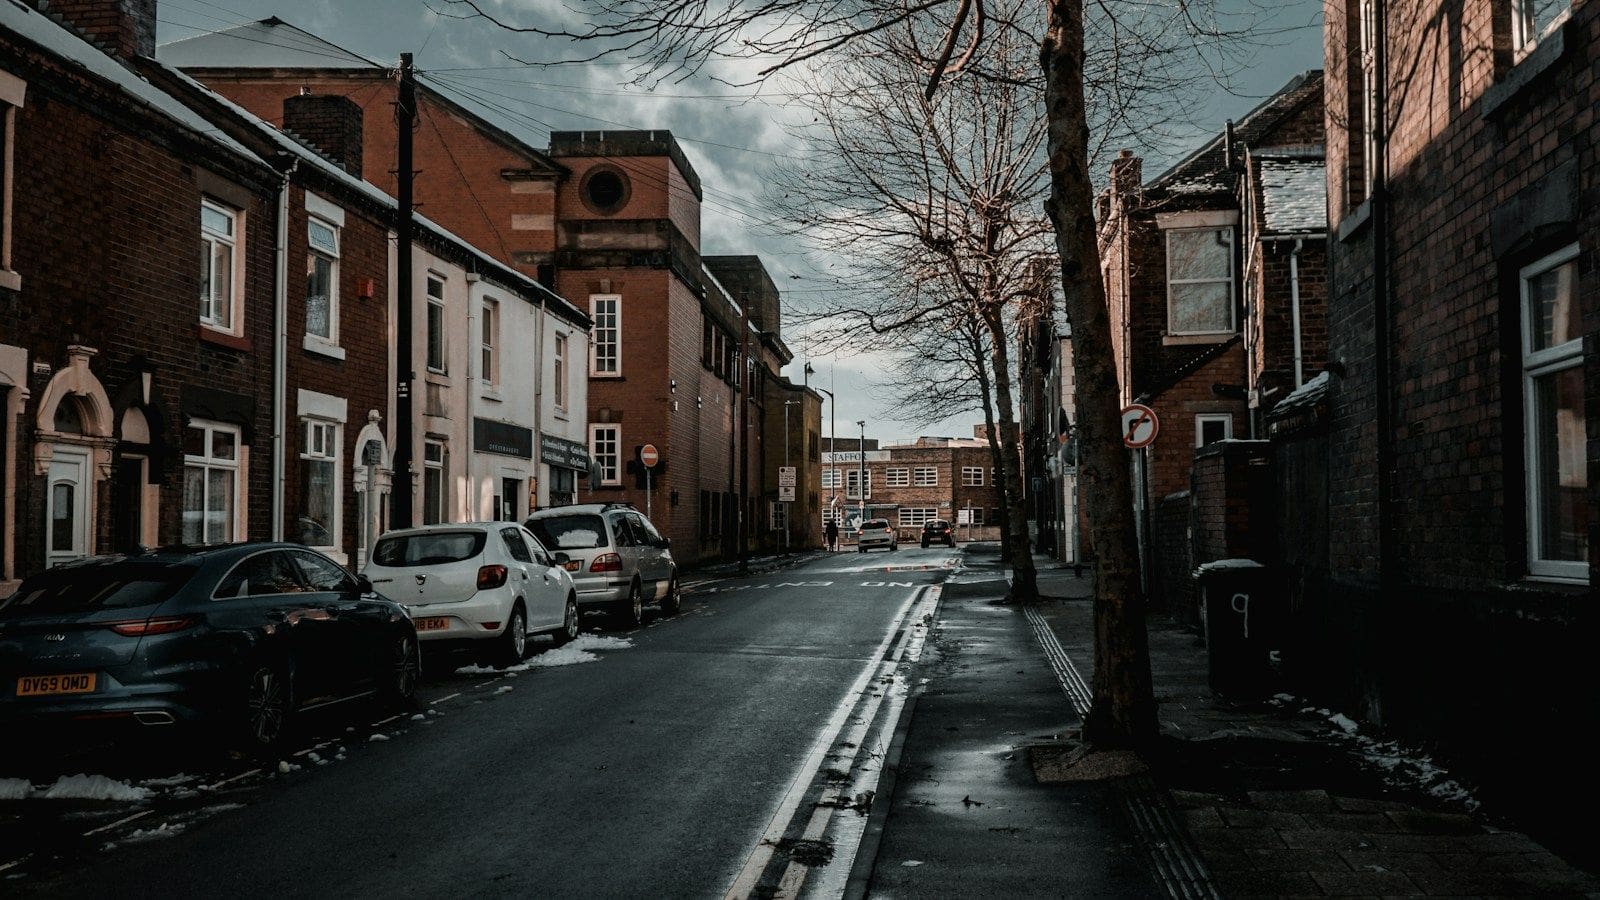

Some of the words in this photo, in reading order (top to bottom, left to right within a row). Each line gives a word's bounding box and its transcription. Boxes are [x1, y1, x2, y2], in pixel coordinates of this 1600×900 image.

[427, 619, 444, 629] EKA
[1231, 593, 1249, 638] 9
[22, 677, 58, 693] DV69
[61, 675, 89, 690] OMD
